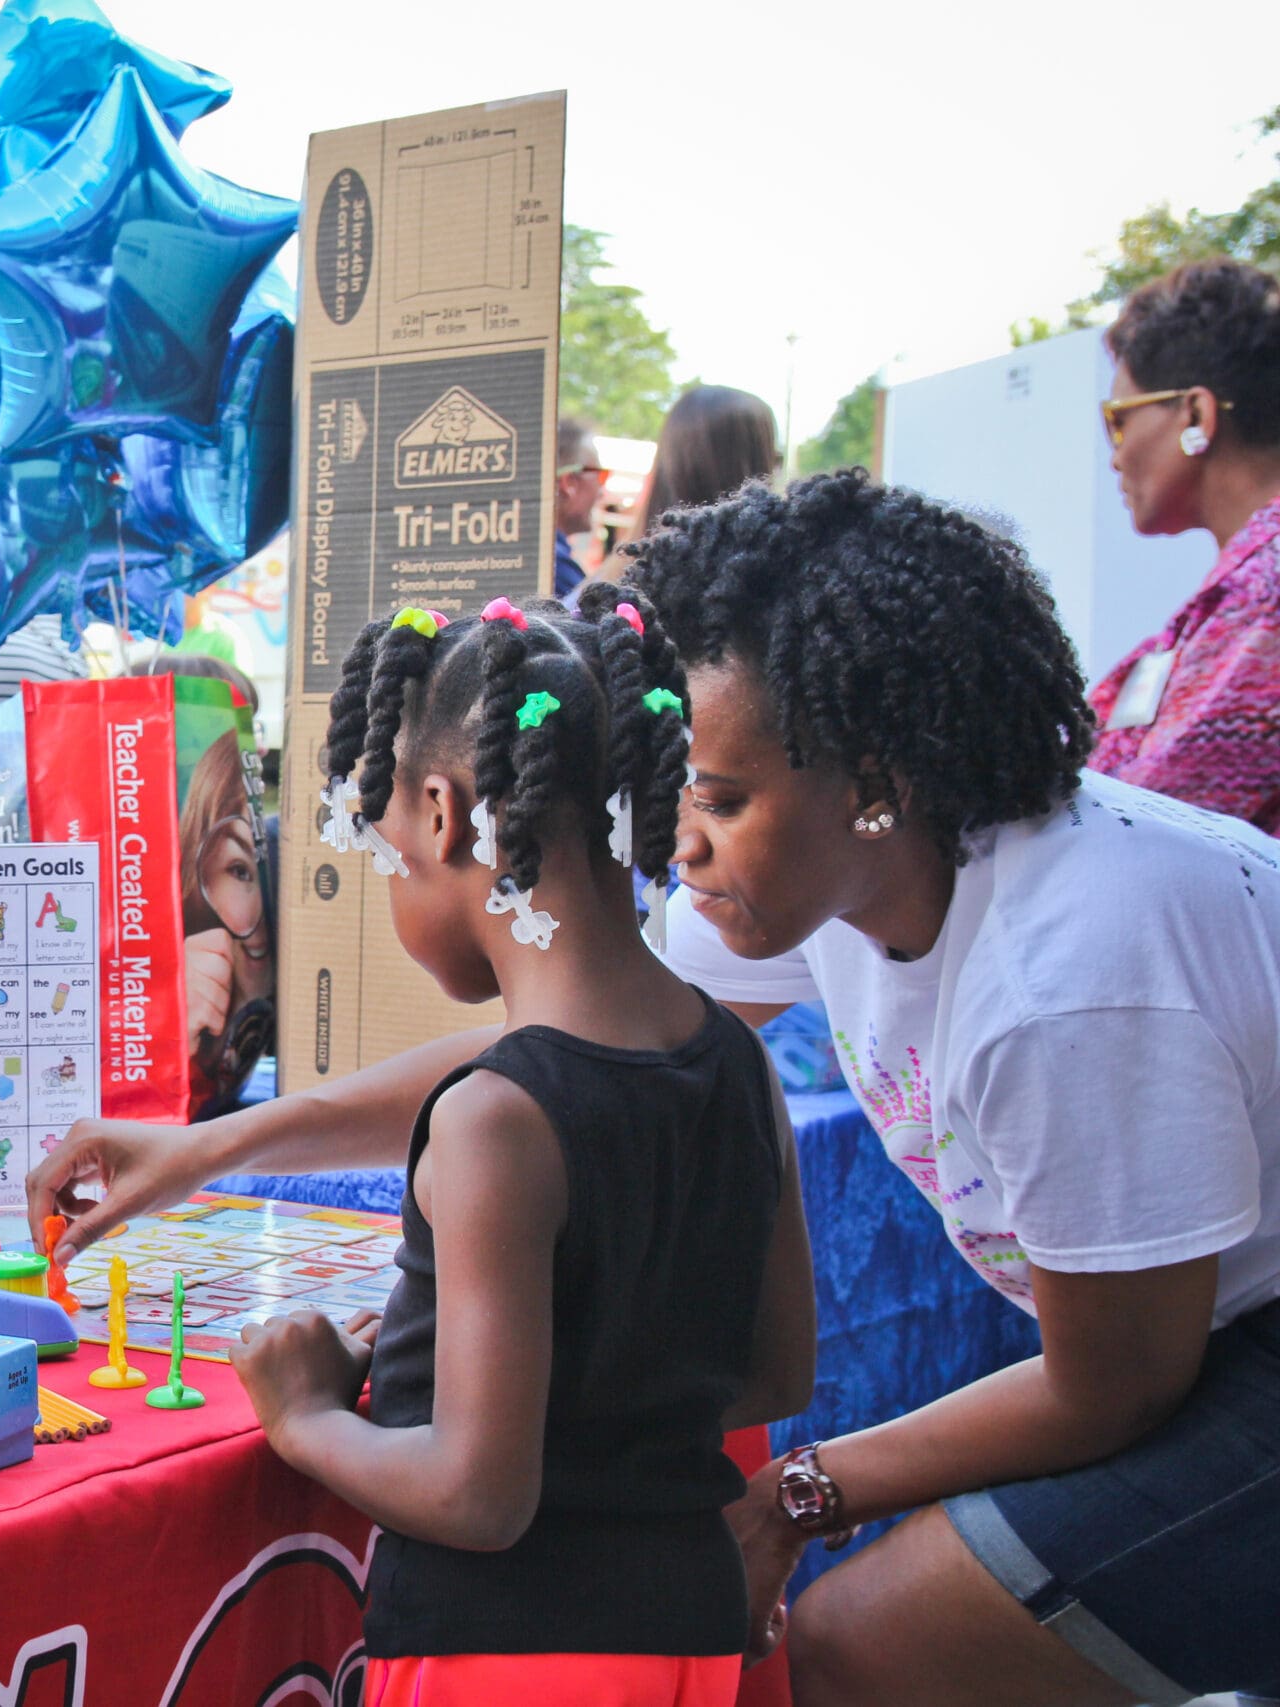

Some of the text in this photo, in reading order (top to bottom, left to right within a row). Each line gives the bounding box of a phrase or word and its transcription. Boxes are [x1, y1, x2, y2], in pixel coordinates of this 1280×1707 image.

[337, 211, 348, 236] cm
[335, 295, 346, 321] cm
[402, 444, 508, 478] ELMER'S
[311, 399, 337, 666] Tri-Fold Display Board
[393, 500, 521, 548] Tri-Fold
[399, 554, 522, 574] Sturdy corrugated board
[398, 576, 477, 592] Smooth surface
[23, 858, 85, 877] Goals
[115, 718, 153, 1082] Teacher Created Materials
[7, 942, 19, 951] my
[41, 940, 60, 948] know
[63, 939, 72, 948] all
[74, 941, 86, 950] my
[36, 953, 55, 961] letter
[33, 979, 49, 988] the
[5, 1011, 20, 1021] my
[71, 1009, 86, 1017] my
[108, 959, 122, 1082] PUBLISHING
[318, 975, 329, 1066] WHITE INSIDE
[46, 1034, 63, 1045] sight
[58, 1087, 86, 1095] identify
[8, 1370, 22, 1380] Ages
